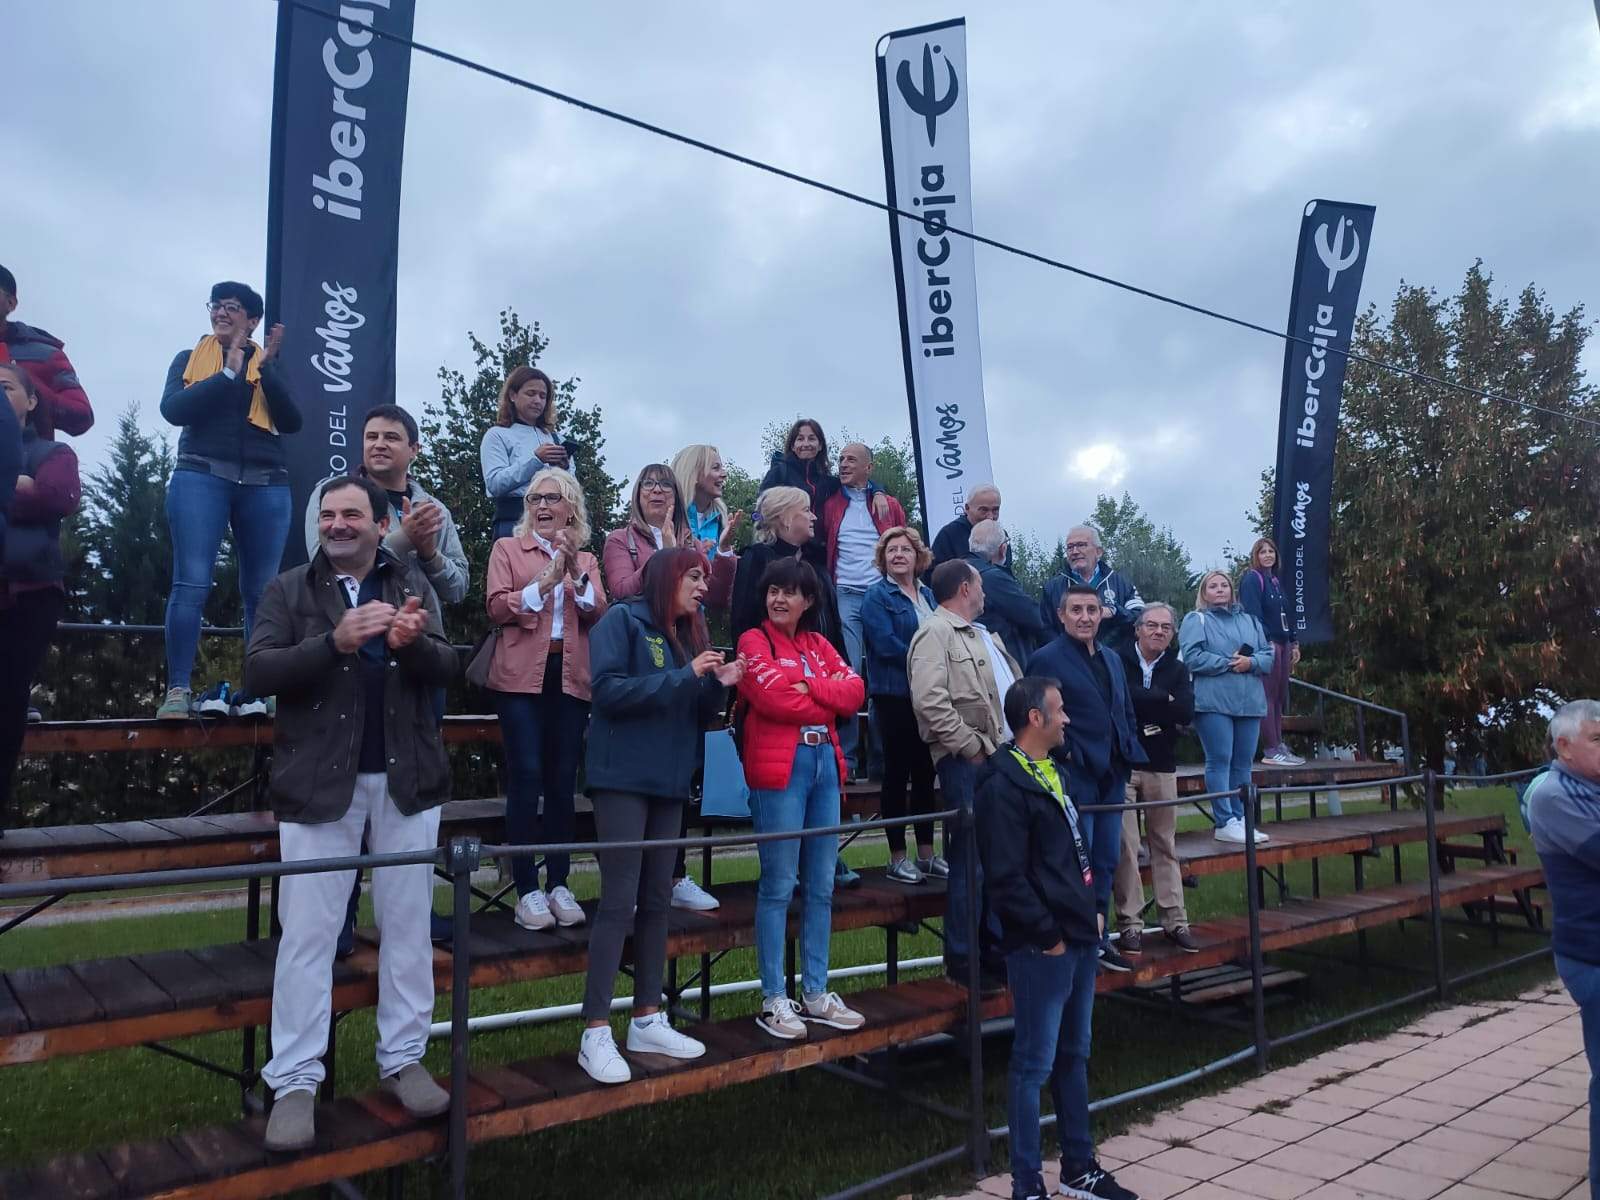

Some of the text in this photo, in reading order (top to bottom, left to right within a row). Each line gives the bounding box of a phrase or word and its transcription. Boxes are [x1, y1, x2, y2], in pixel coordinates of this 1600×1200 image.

[912, 164, 956, 358] iberCaja
[310, 280, 366, 393] Vamos
[1296, 303, 1338, 448] iberCaja
[329, 404, 348, 447] DEL
[935, 402, 966, 516] DEL Vamos
[1291, 481, 1312, 630] EL BANCO DEL Vamos
